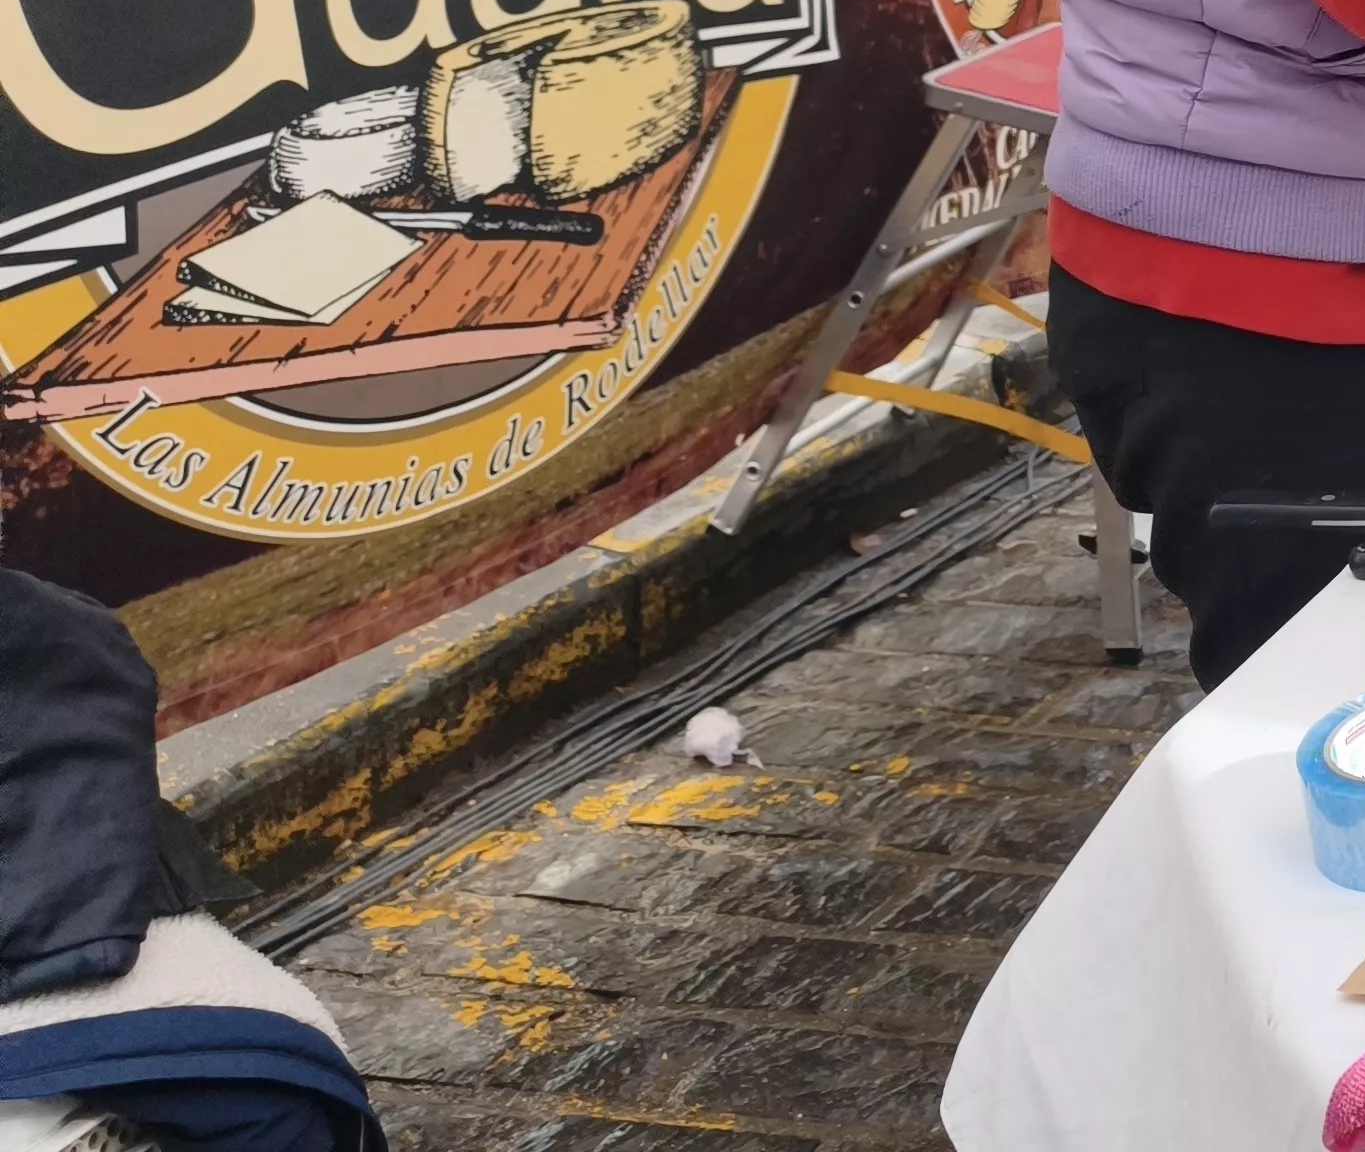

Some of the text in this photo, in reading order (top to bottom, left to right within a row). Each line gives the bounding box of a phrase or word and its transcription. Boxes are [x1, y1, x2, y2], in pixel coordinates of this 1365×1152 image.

[93, 211, 725, 528] Las Almunias de Rodellar
